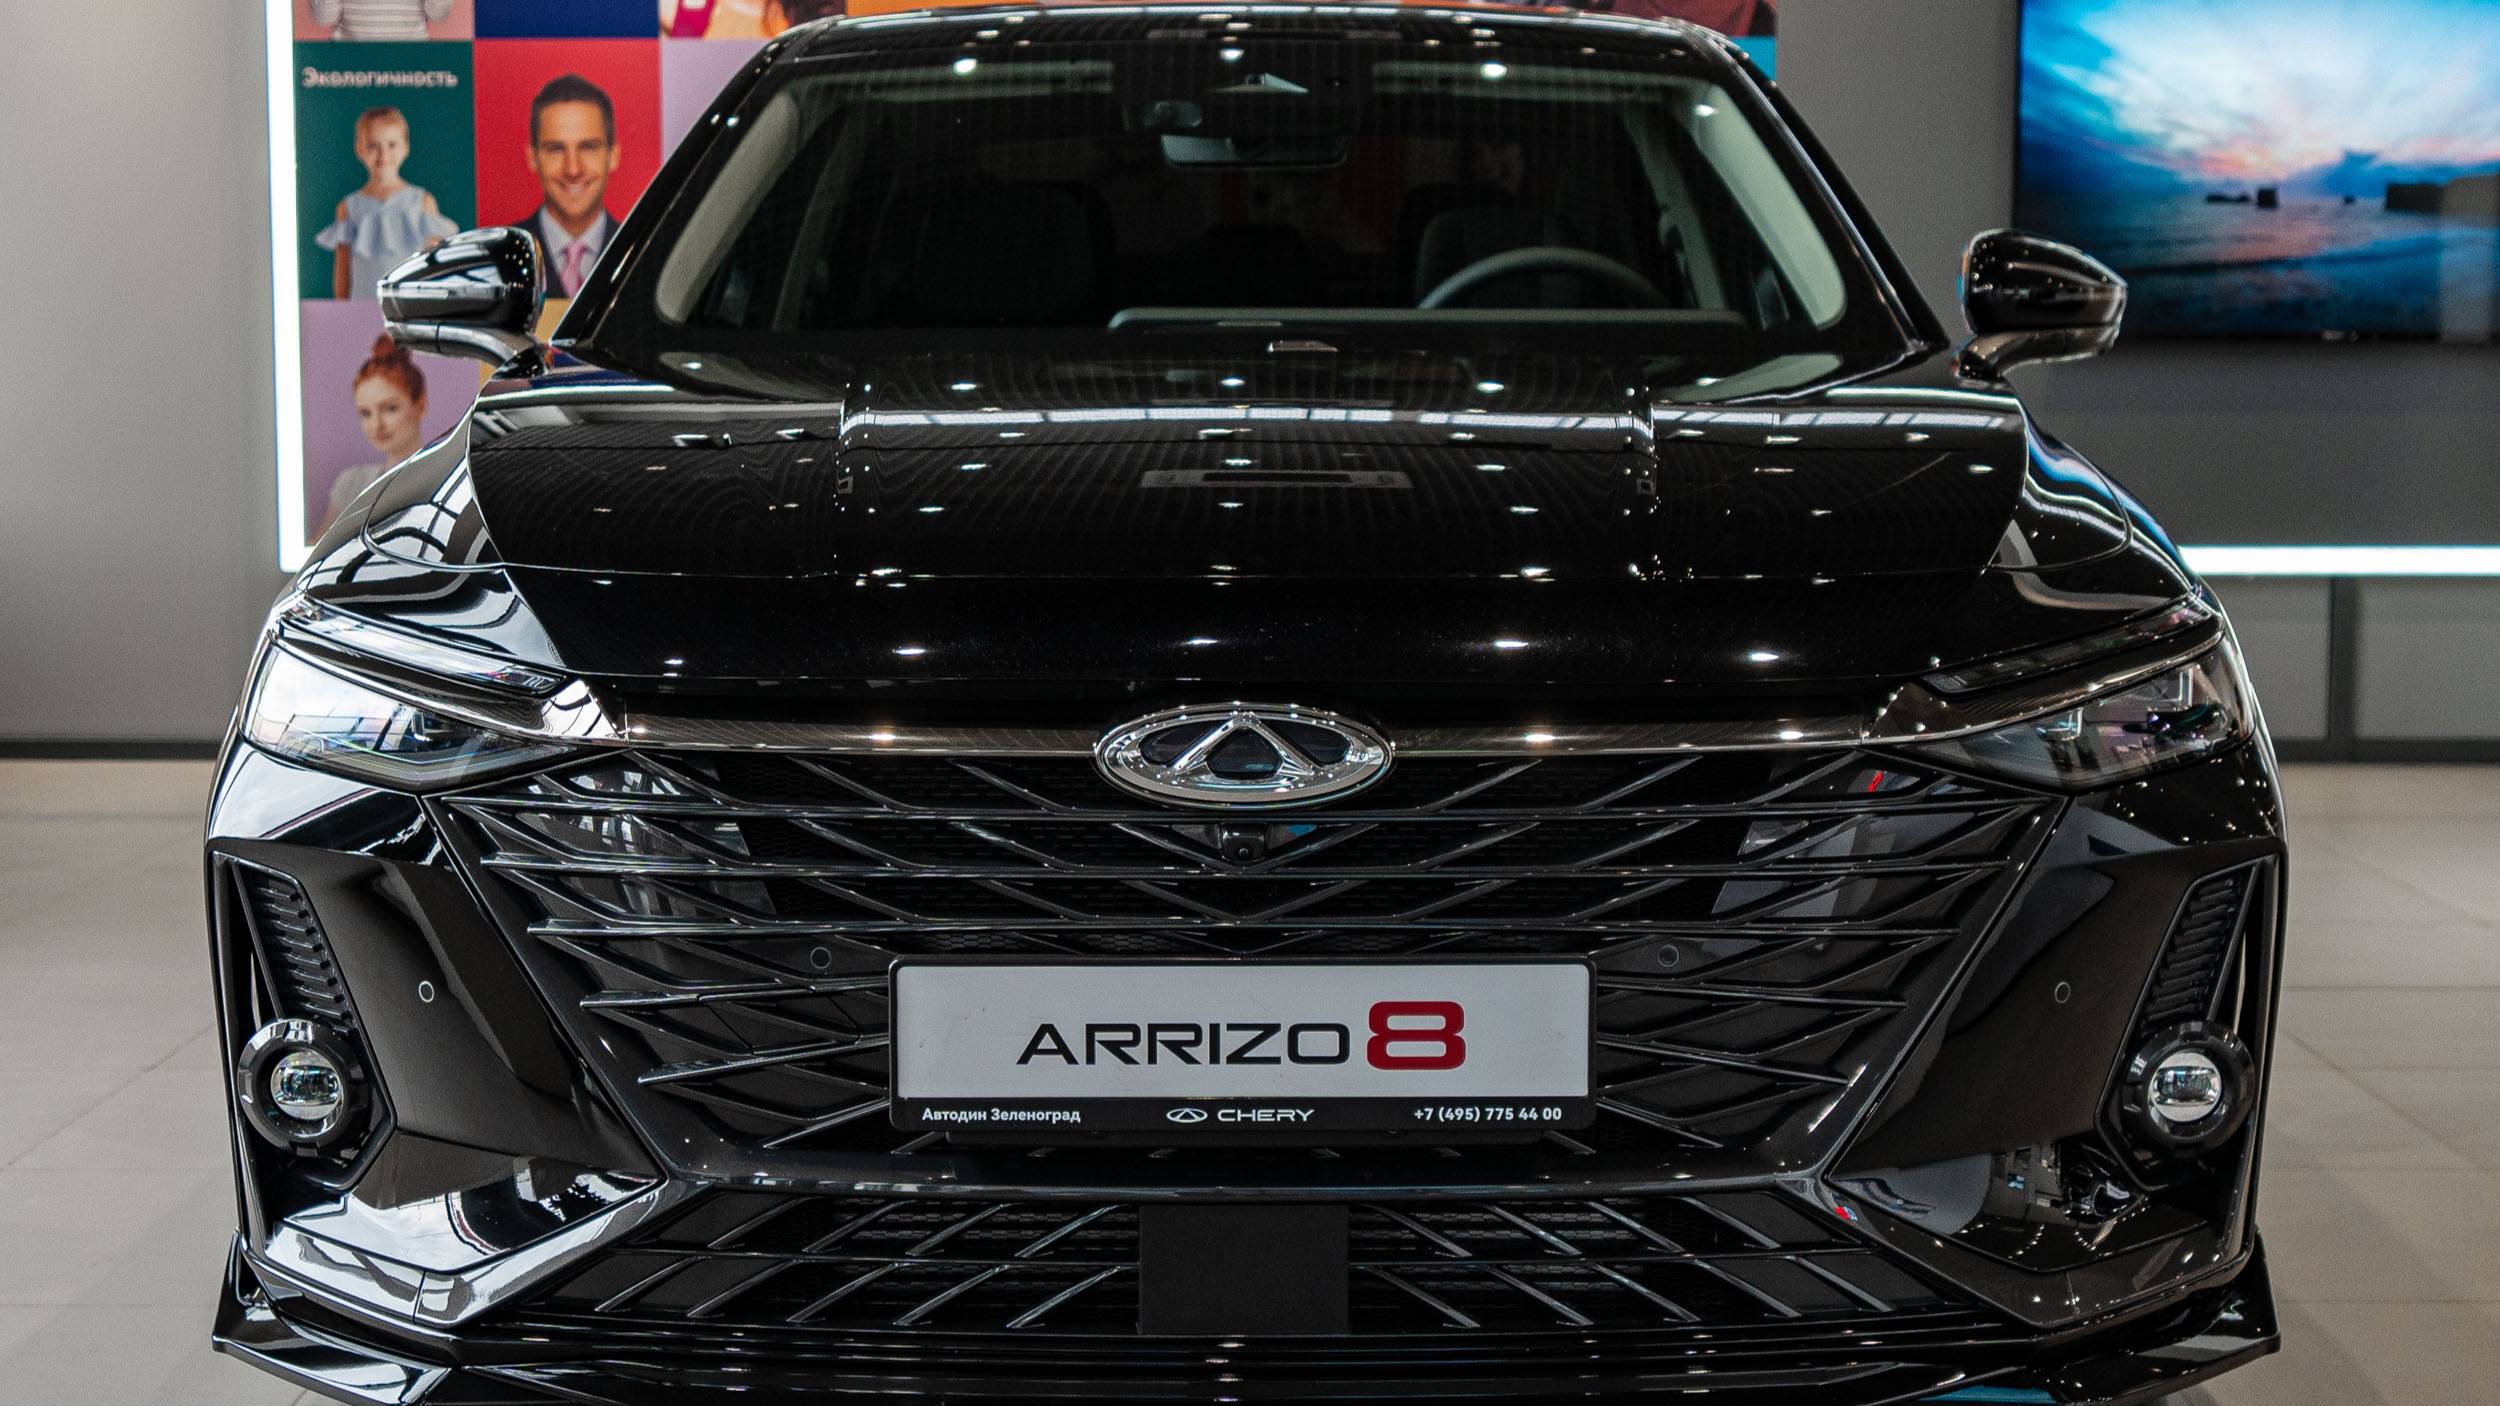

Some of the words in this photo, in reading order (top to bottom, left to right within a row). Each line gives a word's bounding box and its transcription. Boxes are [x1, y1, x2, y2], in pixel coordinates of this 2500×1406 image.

[303, 67, 458, 88] Экологичность
[1016, 1022, 1351, 1066] ARRIZO
[1366, 1000, 1467, 1071] 8
[922, 1106, 987, 1124] Автодин
[990, 1106, 1082, 1125] Зеленоград
[1217, 1108, 1315, 1122] CHERY
[1414, 1107, 1434, 1121] +7
[1438, 1106, 1481, 1123] (495)
[1485, 1107, 1514, 1121] 775
[1518, 1107, 1539, 1121] 44
[1542, 1107, 1562, 1121] 00
